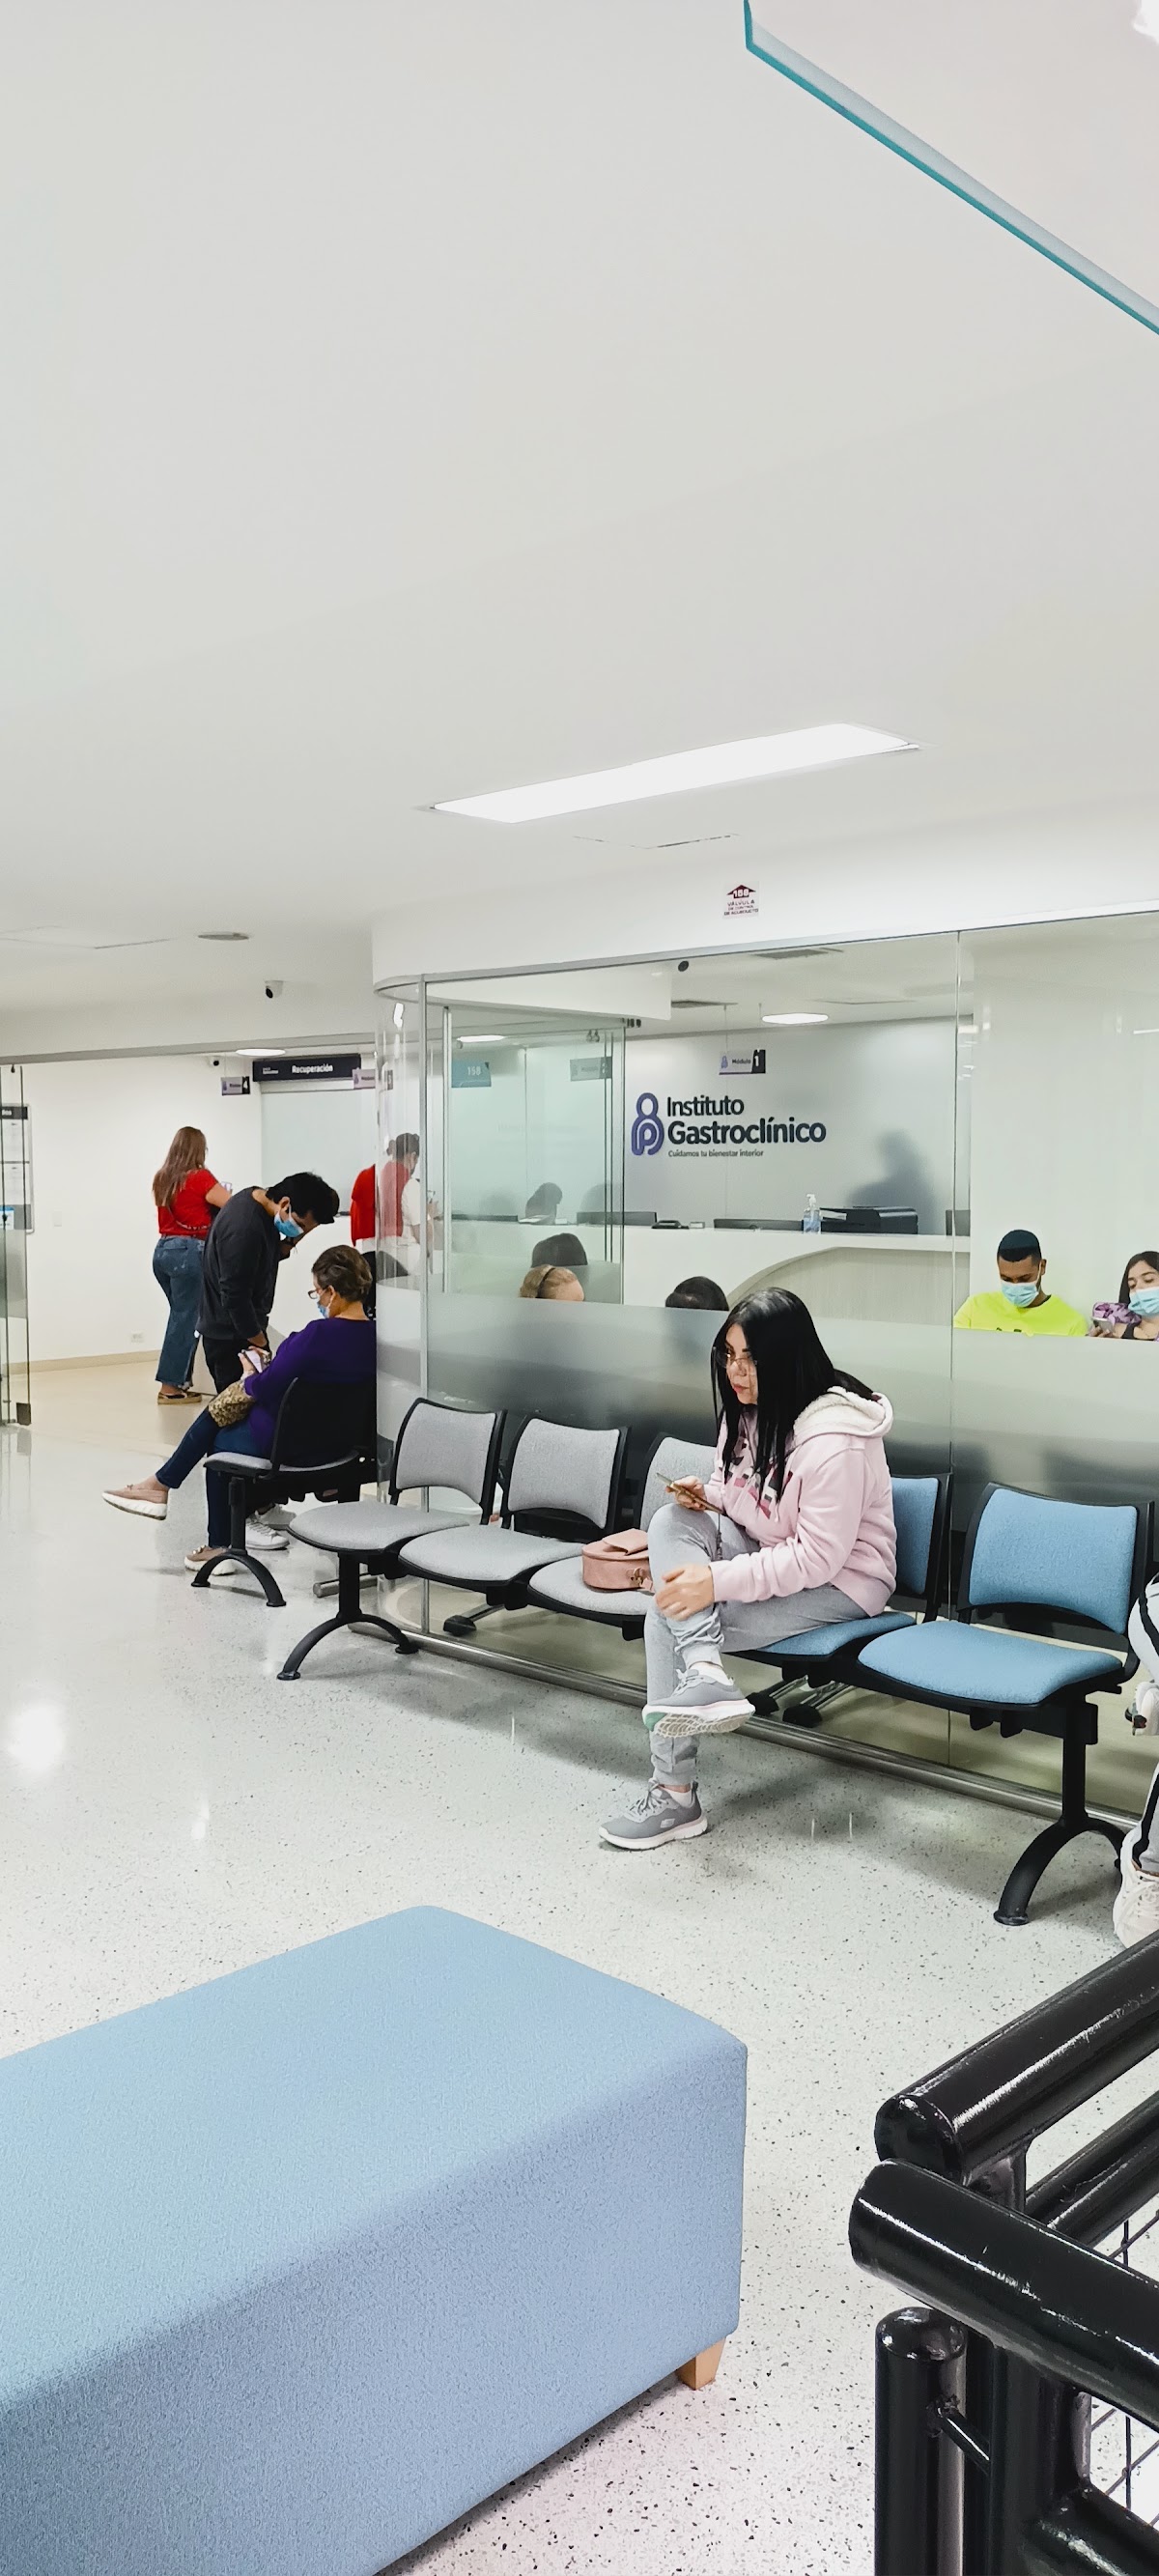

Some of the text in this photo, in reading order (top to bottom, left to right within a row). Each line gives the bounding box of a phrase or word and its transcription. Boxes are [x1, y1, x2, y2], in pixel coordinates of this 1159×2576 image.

[754, 1055, 759, 1067] 1
[292, 1063, 333, 1074] Recuperación
[666, 1094, 745, 1118] Instituto
[667, 1117, 827, 1145] Gastroclínico
[667, 1149, 699, 1158] Cuidamos
[740, 1148, 764, 1157] interior
